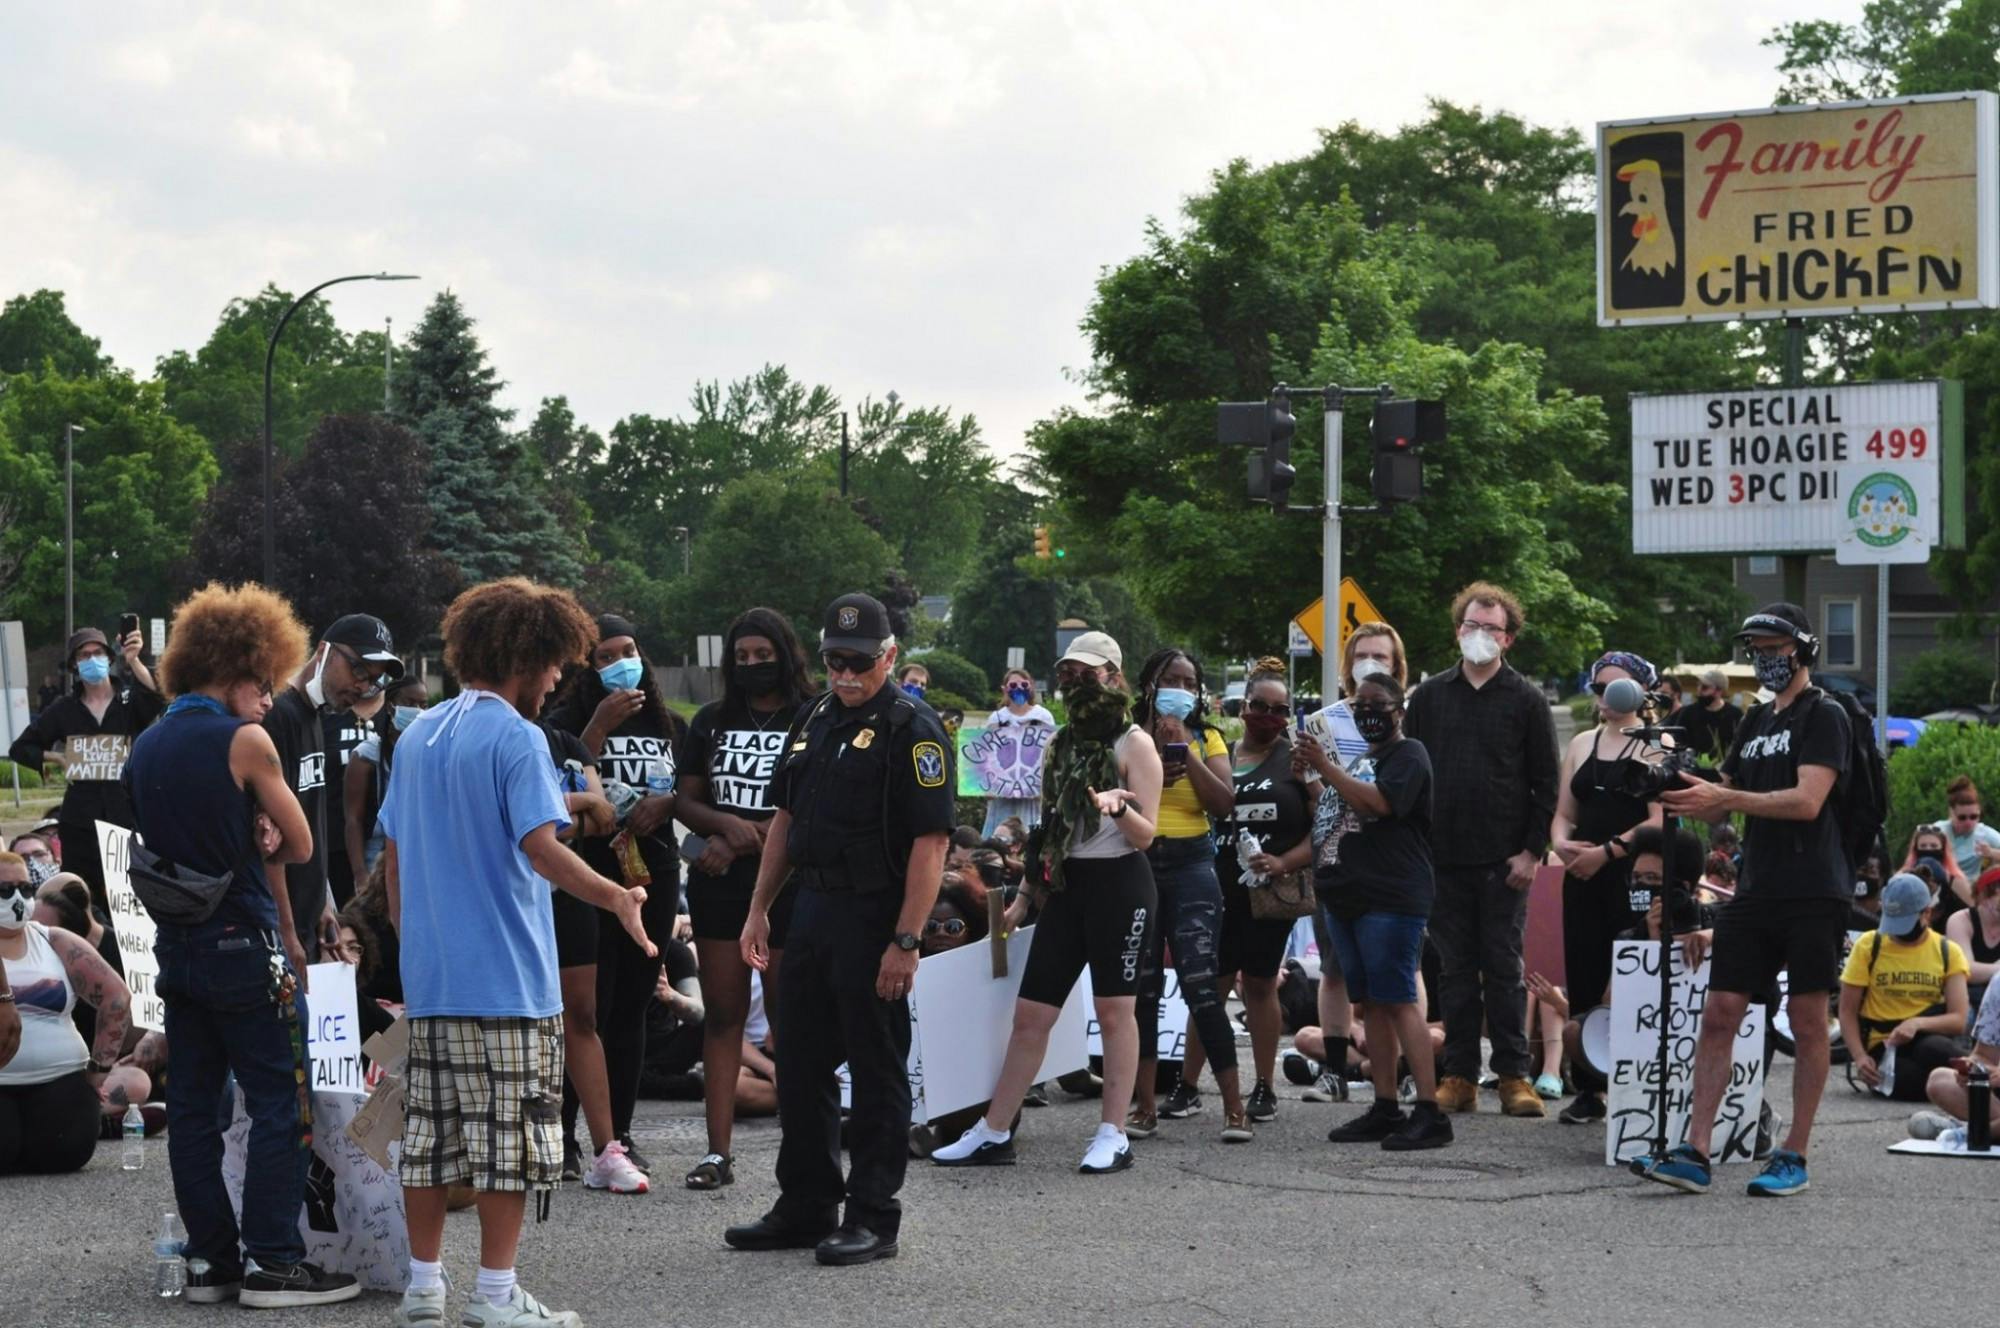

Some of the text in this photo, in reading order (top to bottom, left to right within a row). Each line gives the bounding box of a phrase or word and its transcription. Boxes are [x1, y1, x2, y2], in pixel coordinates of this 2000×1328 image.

[1696, 108, 1926, 220] Family
[1753, 204, 1913, 243] FRIED
[1706, 394, 1841, 429] SPECIAL
[1653, 427, 1927, 468] TUE HOAGIE 499
[1651, 470, 1837, 506] WED 3PC DI
[73, 736, 122, 753] BLACK
[83, 751, 117, 762] LIVES
[961, 728, 1011, 764] CARE
[711, 751, 777, 778] LIVE
[118, 930, 150, 955] WHEN
[1121, 908, 1146, 981] adidas
[1636, 1003, 1755, 1038] ROOTG
[1658, 1034, 1696, 1062] FO
[1613, 1059, 1760, 1087] EVERYDY
